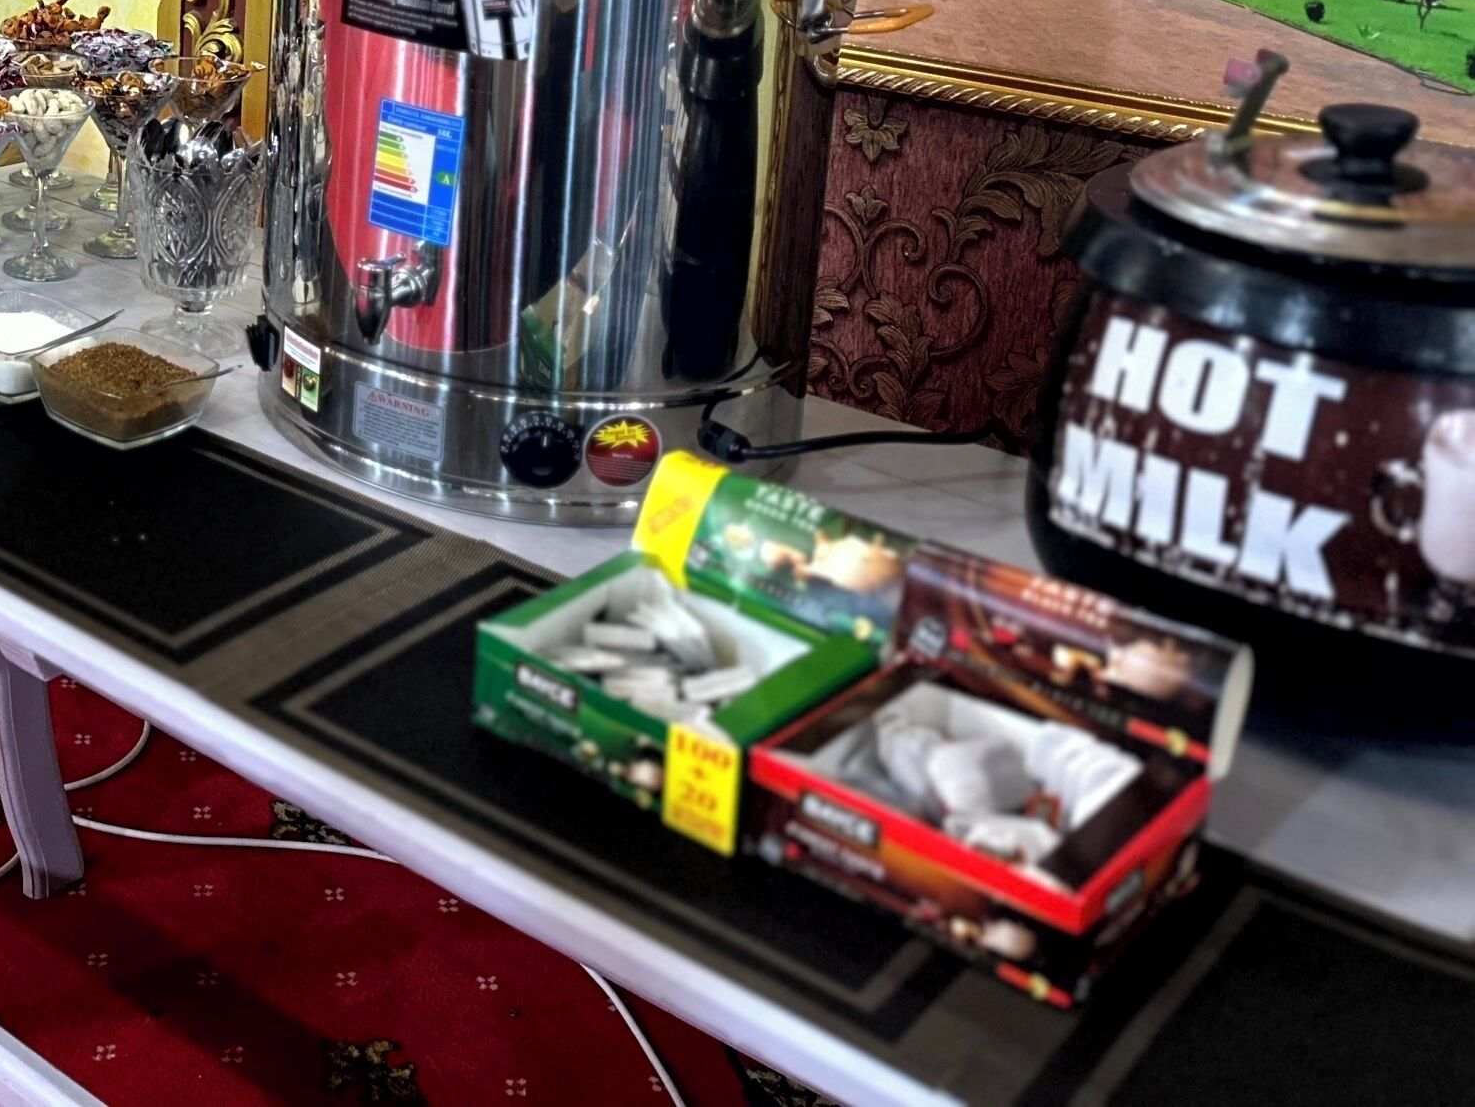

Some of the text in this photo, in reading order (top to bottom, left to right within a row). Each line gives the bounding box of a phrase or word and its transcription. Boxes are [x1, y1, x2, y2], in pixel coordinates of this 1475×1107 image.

[376, 395, 430, 417] WARNING
[1091, 315, 1347, 462] HOT
[1057, 423, 1351, 601] MILK
[675, 732, 732, 771] 100
[680, 782, 718, 813] 20
